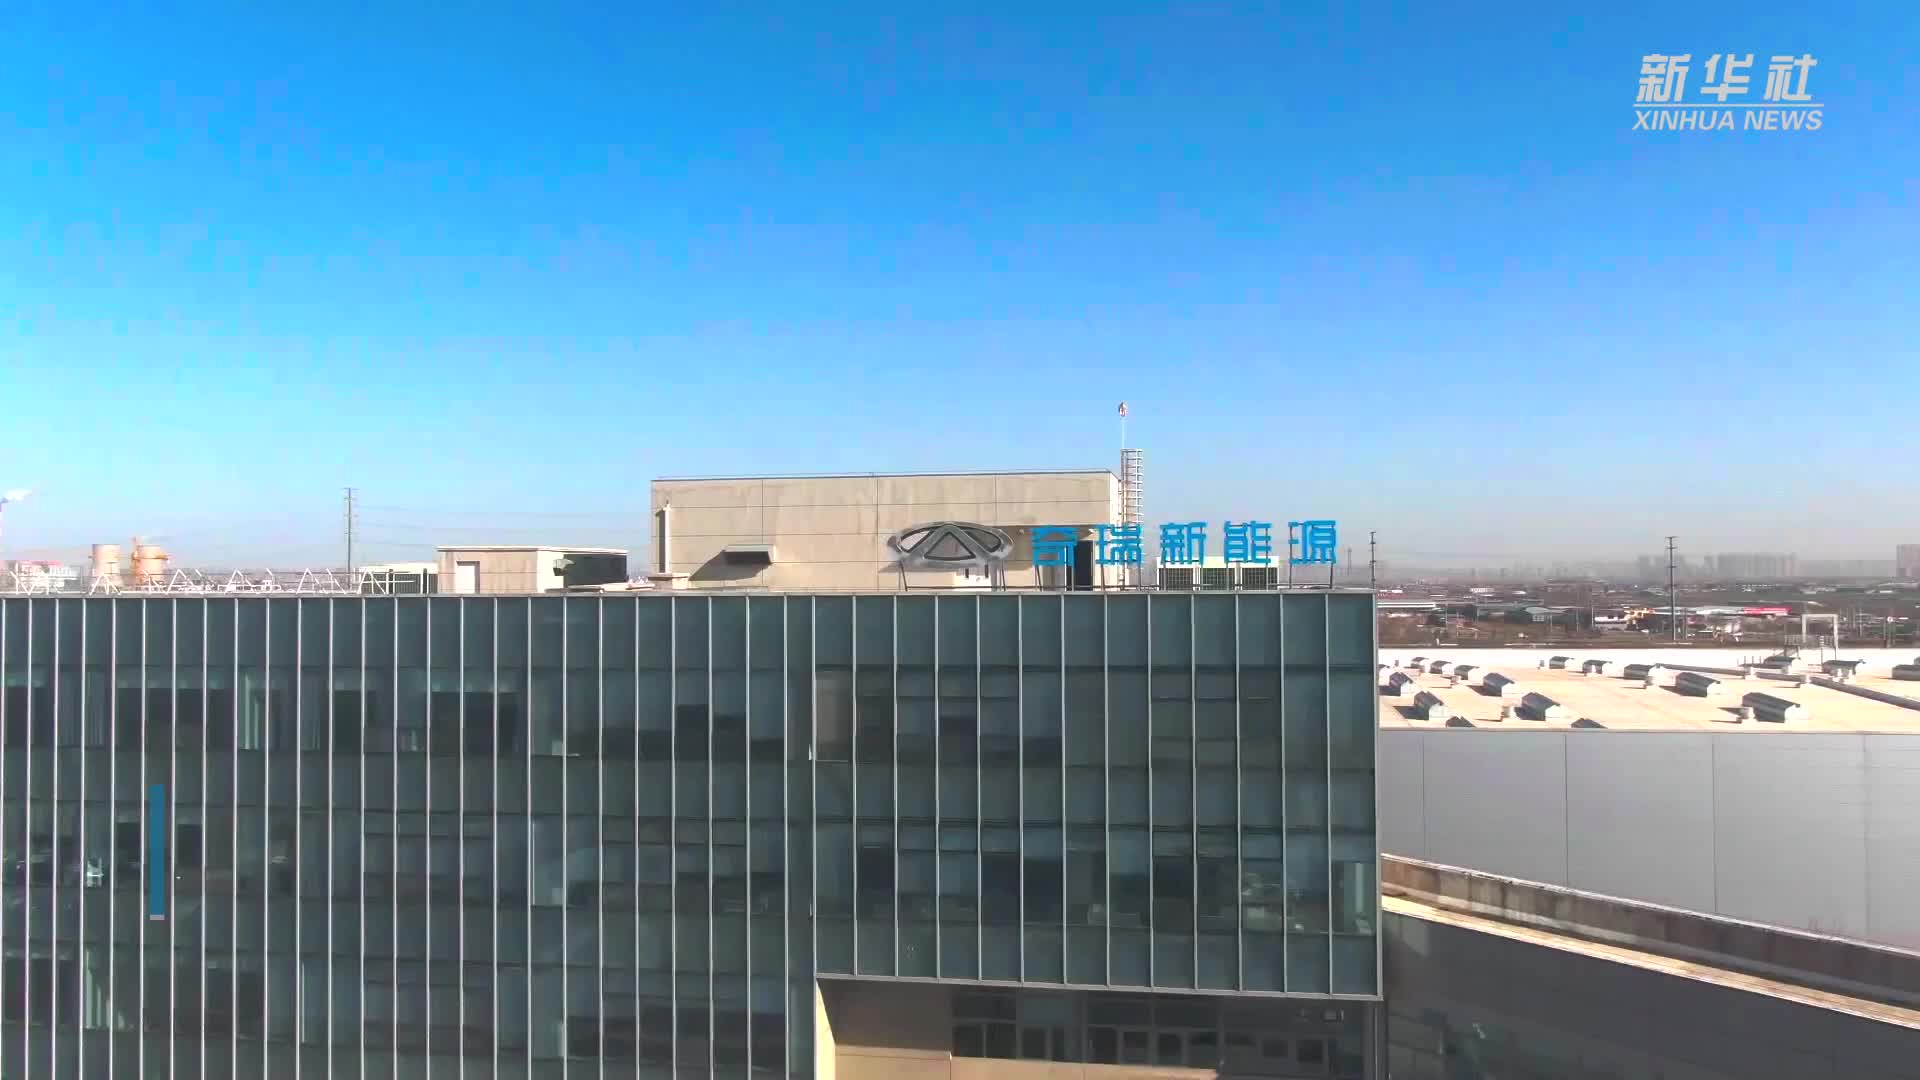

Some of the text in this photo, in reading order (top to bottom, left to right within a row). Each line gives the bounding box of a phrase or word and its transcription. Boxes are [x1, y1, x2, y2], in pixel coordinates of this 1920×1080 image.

[1031, 520, 1336, 566] 奇瑞新能源
